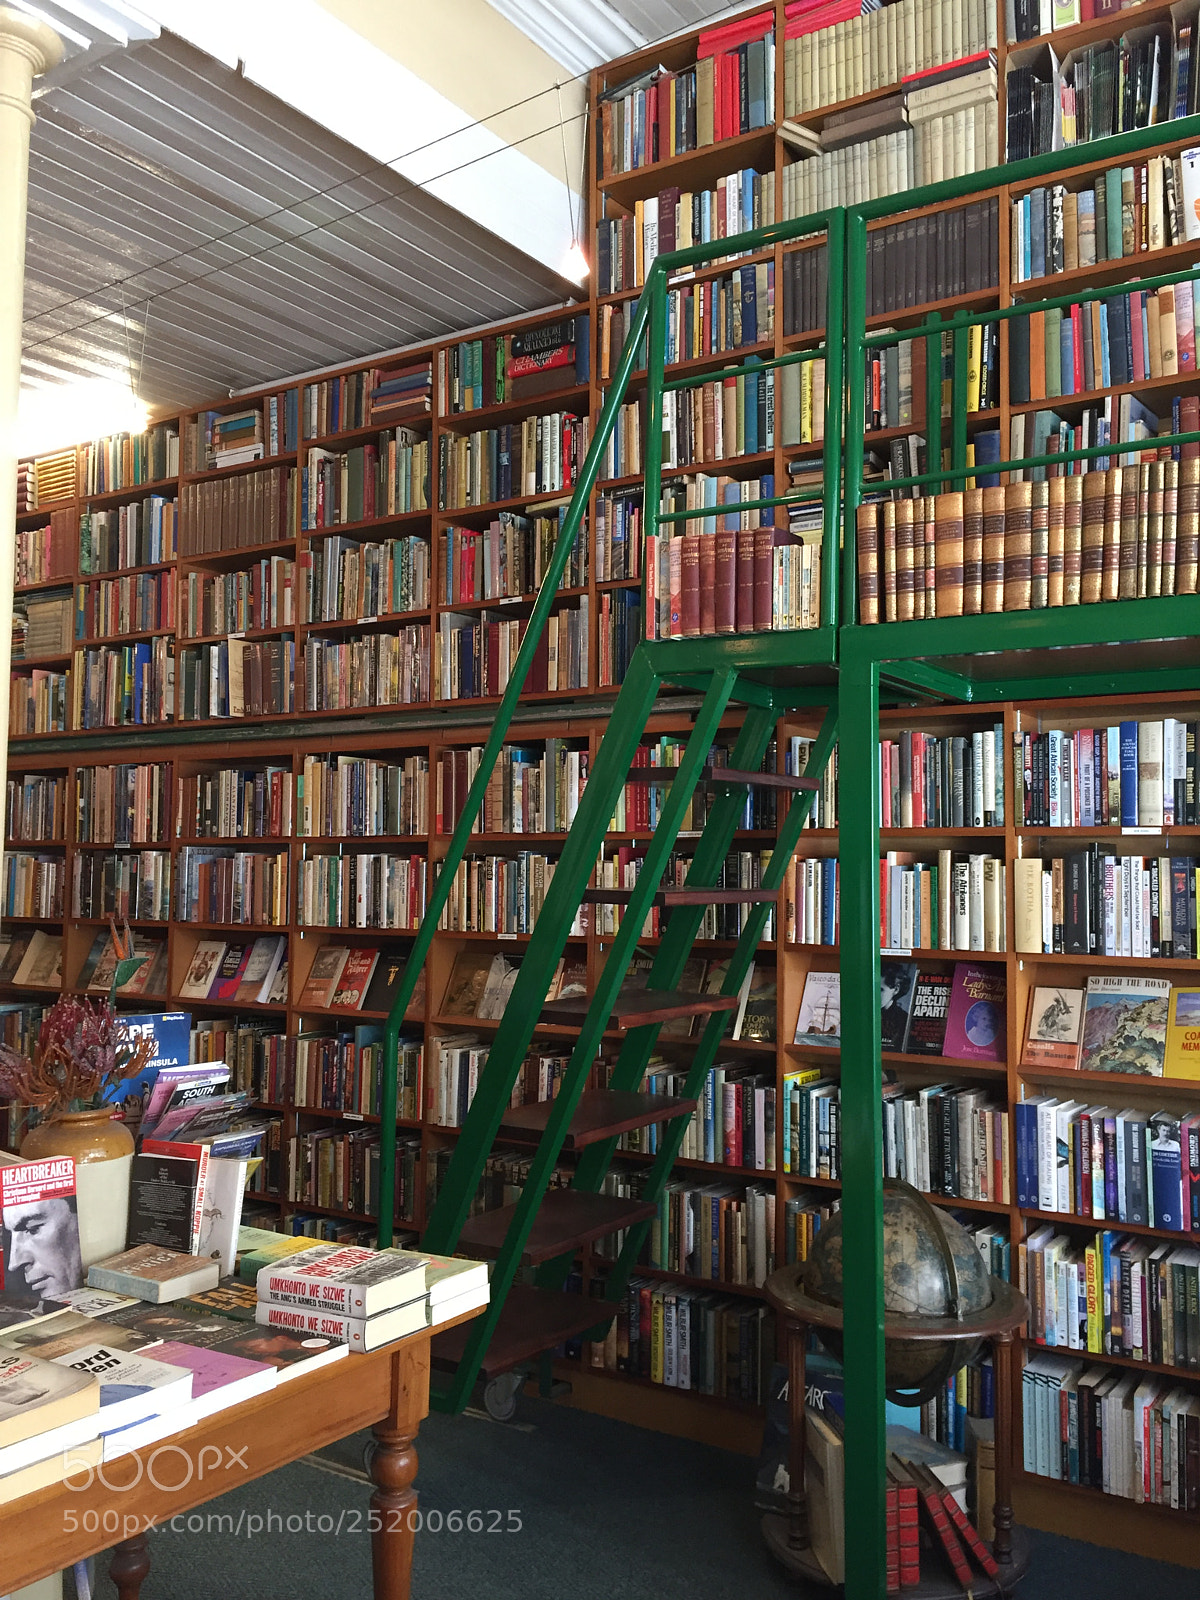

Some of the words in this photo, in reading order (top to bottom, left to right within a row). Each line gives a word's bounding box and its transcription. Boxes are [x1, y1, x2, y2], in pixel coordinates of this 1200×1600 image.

[514, 357, 554, 372] DICTIONARY
[515, 347, 564, 365] CHAMBERS
[1050, 736, 1058, 754] Great
[1187, 732, 1195, 752] JETLAG
[1050, 754, 1058, 776] African
[1050, 777, 1058, 800] Society
[1050, 801, 1058, 816] Biko
[959, 864, 968, 877] The
[984, 862, 994, 882] PW
[1105, 864, 1114, 901] BROTHERS
[959, 880, 968, 916] Afrikaners
[918, 986, 932, 994] THE
[962, 977, 985, 990] Lady
[1103, 978, 1123, 986] HIGH
[1126, 979, 1142, 987] THE
[1145, 980, 1168, 988] ROAD
[915, 996, 950, 1006] DECLIN
[966, 988, 1004, 1001] Barnard
[743, 1015, 774, 1024] STORM
[1026, 1050, 1041, 1058] The
[182, 1085, 216, 1099] SOUTH
[1093, 1124, 1102, 1149] Stealing
[200, 1151, 209, 1180] MURDER
[1081, 1147, 1090, 1174] CHILDREN
[2, 1160, 74, 1186] HEARTBREAKER
[28, 1184, 46, 1194] Barnard
[46, 1182, 56, 1190] and
[63, 1179, 74, 1188] first
[196, 1186, 205, 1209] SMALL
[294, 1248, 364, 1275] UMKHONTO
[338, 1250, 380, 1269] SIZWE
[1087, 1253, 1095, 1283] RAGGED
[1122, 1262, 1130, 1286] BLACK
[269, 1277, 306, 1296] UMKHONTO
[308, 1283, 320, 1298] WE
[322, 1286, 346, 1304] SIZWE
[1088, 1284, 1096, 1316] GLORY
[270, 1292, 279, 1301] THE
[280, 1293, 296, 1304] ANC'S
[297, 1296, 317, 1308] ARMED
[318, 1300, 346, 1312] STRUGGLE
[1122, 1289, 1130, 1314] DEATH
[268, 1309, 305, 1329] UMKHONTO
[308, 1316, 319, 1332] WE
[321, 1319, 344, 1336] SIZWE
[1133, 1302, 1141, 1334] HARRIS
